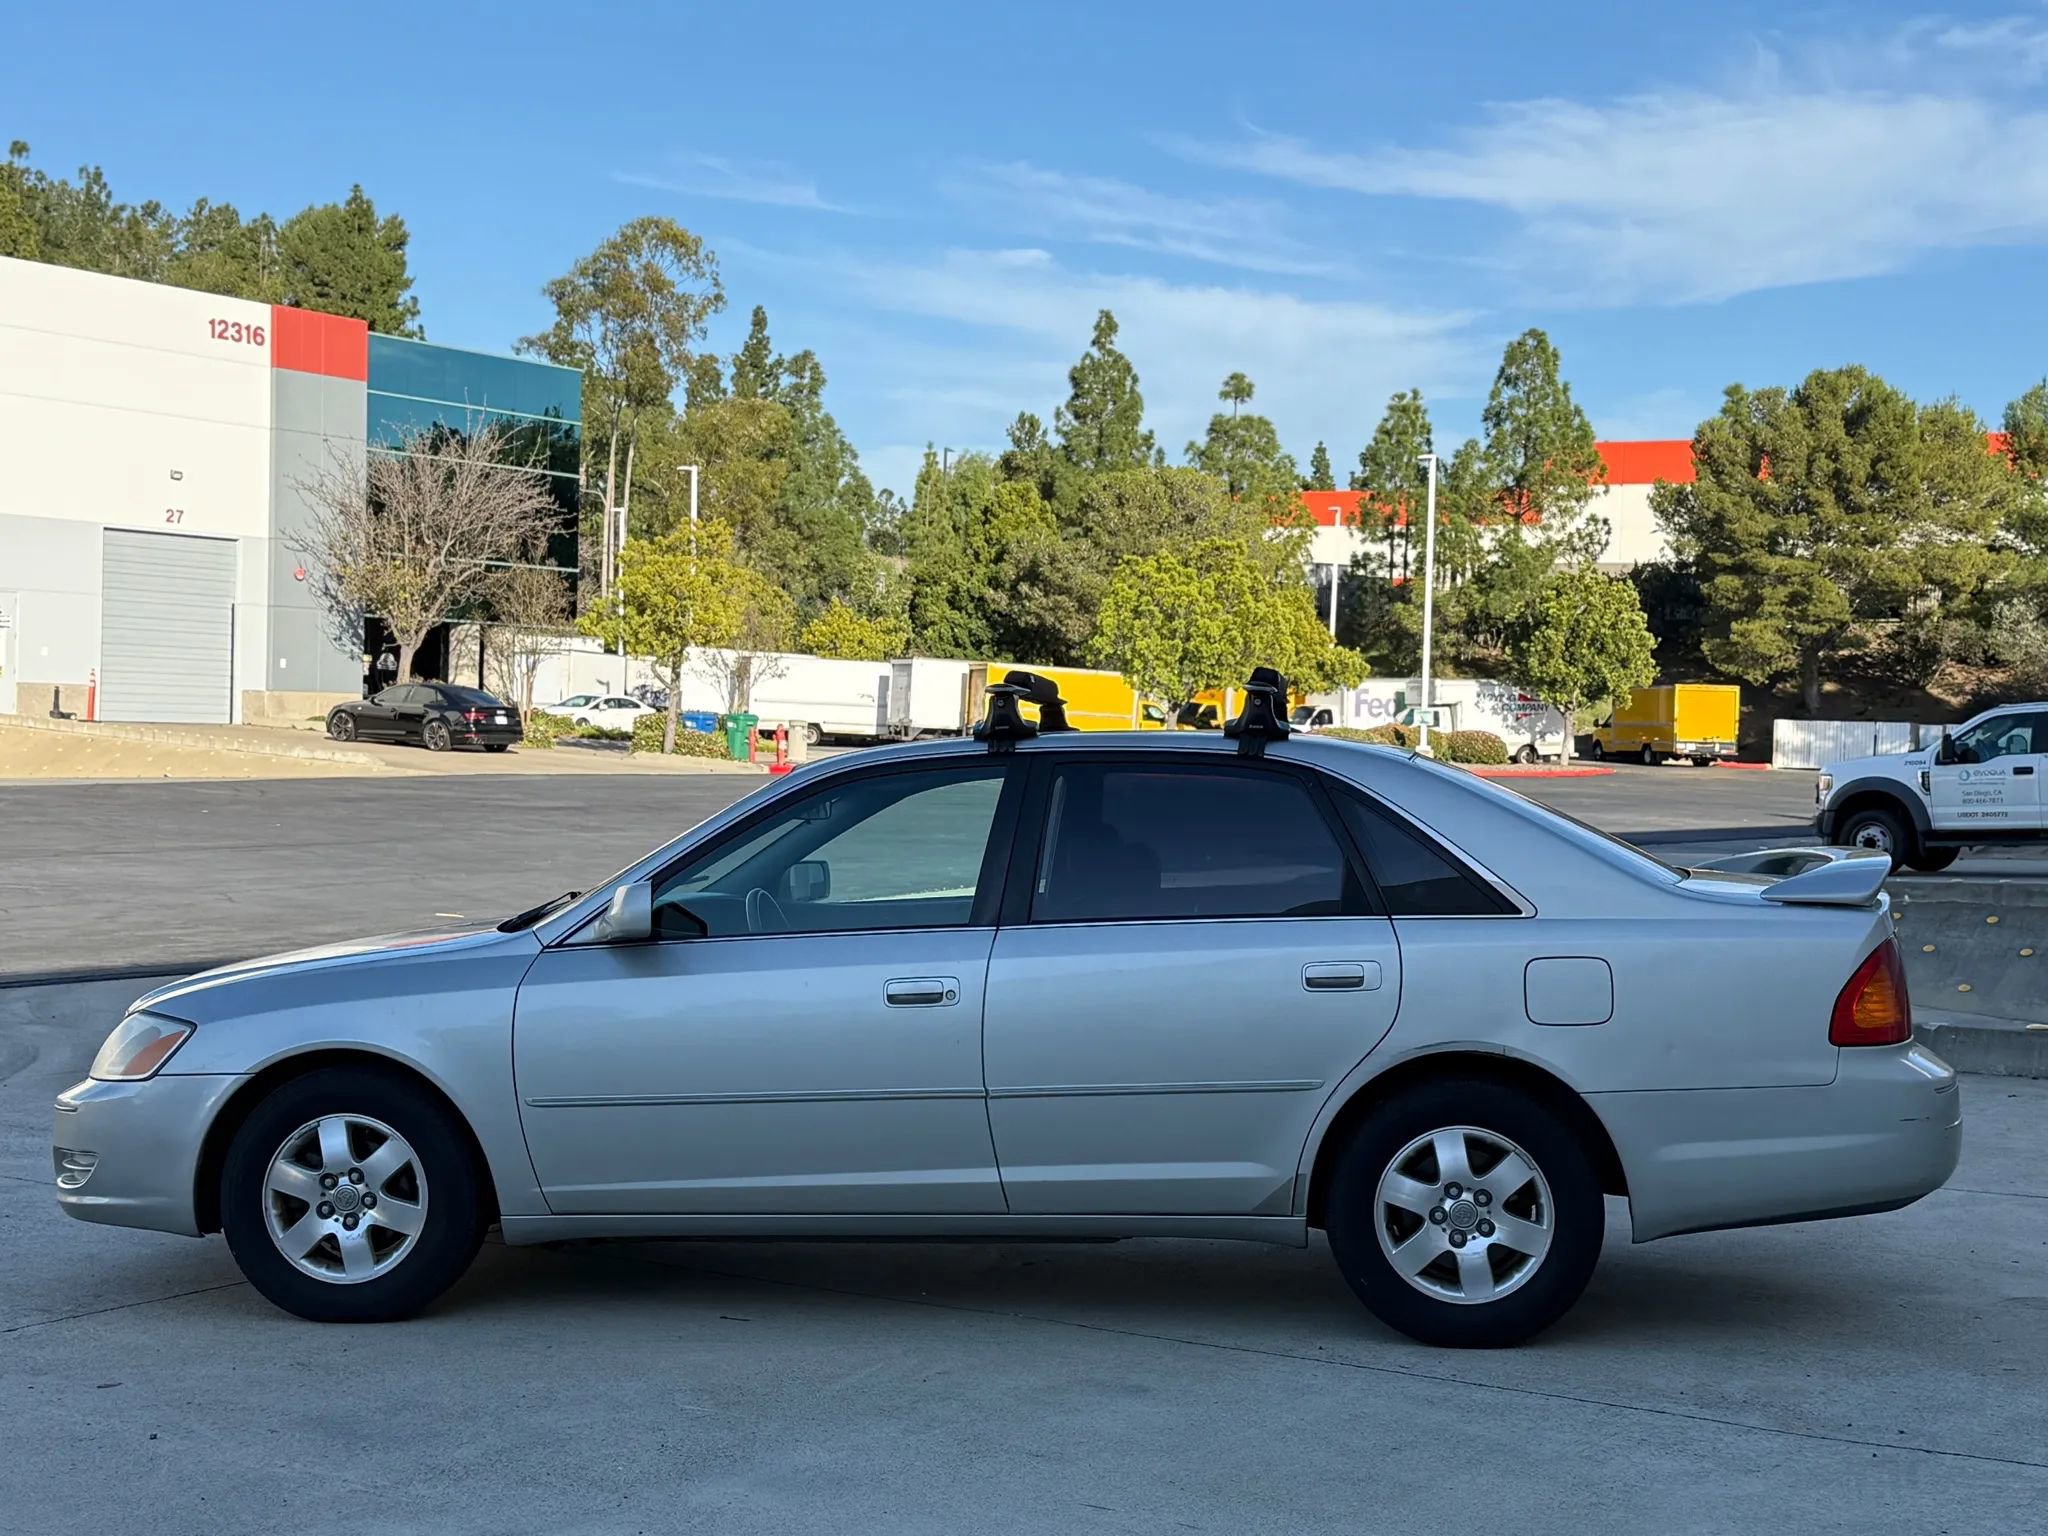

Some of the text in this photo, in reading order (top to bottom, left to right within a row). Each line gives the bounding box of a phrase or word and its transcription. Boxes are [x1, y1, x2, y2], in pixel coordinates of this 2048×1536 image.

[208, 318, 266, 346] 12316
[166, 508, 184, 524] 27
[1501, 703, 1549, 713] COMPANY
[1974, 790, 1993, 798] Diego,
[1993, 788, 2002, 796] CA
